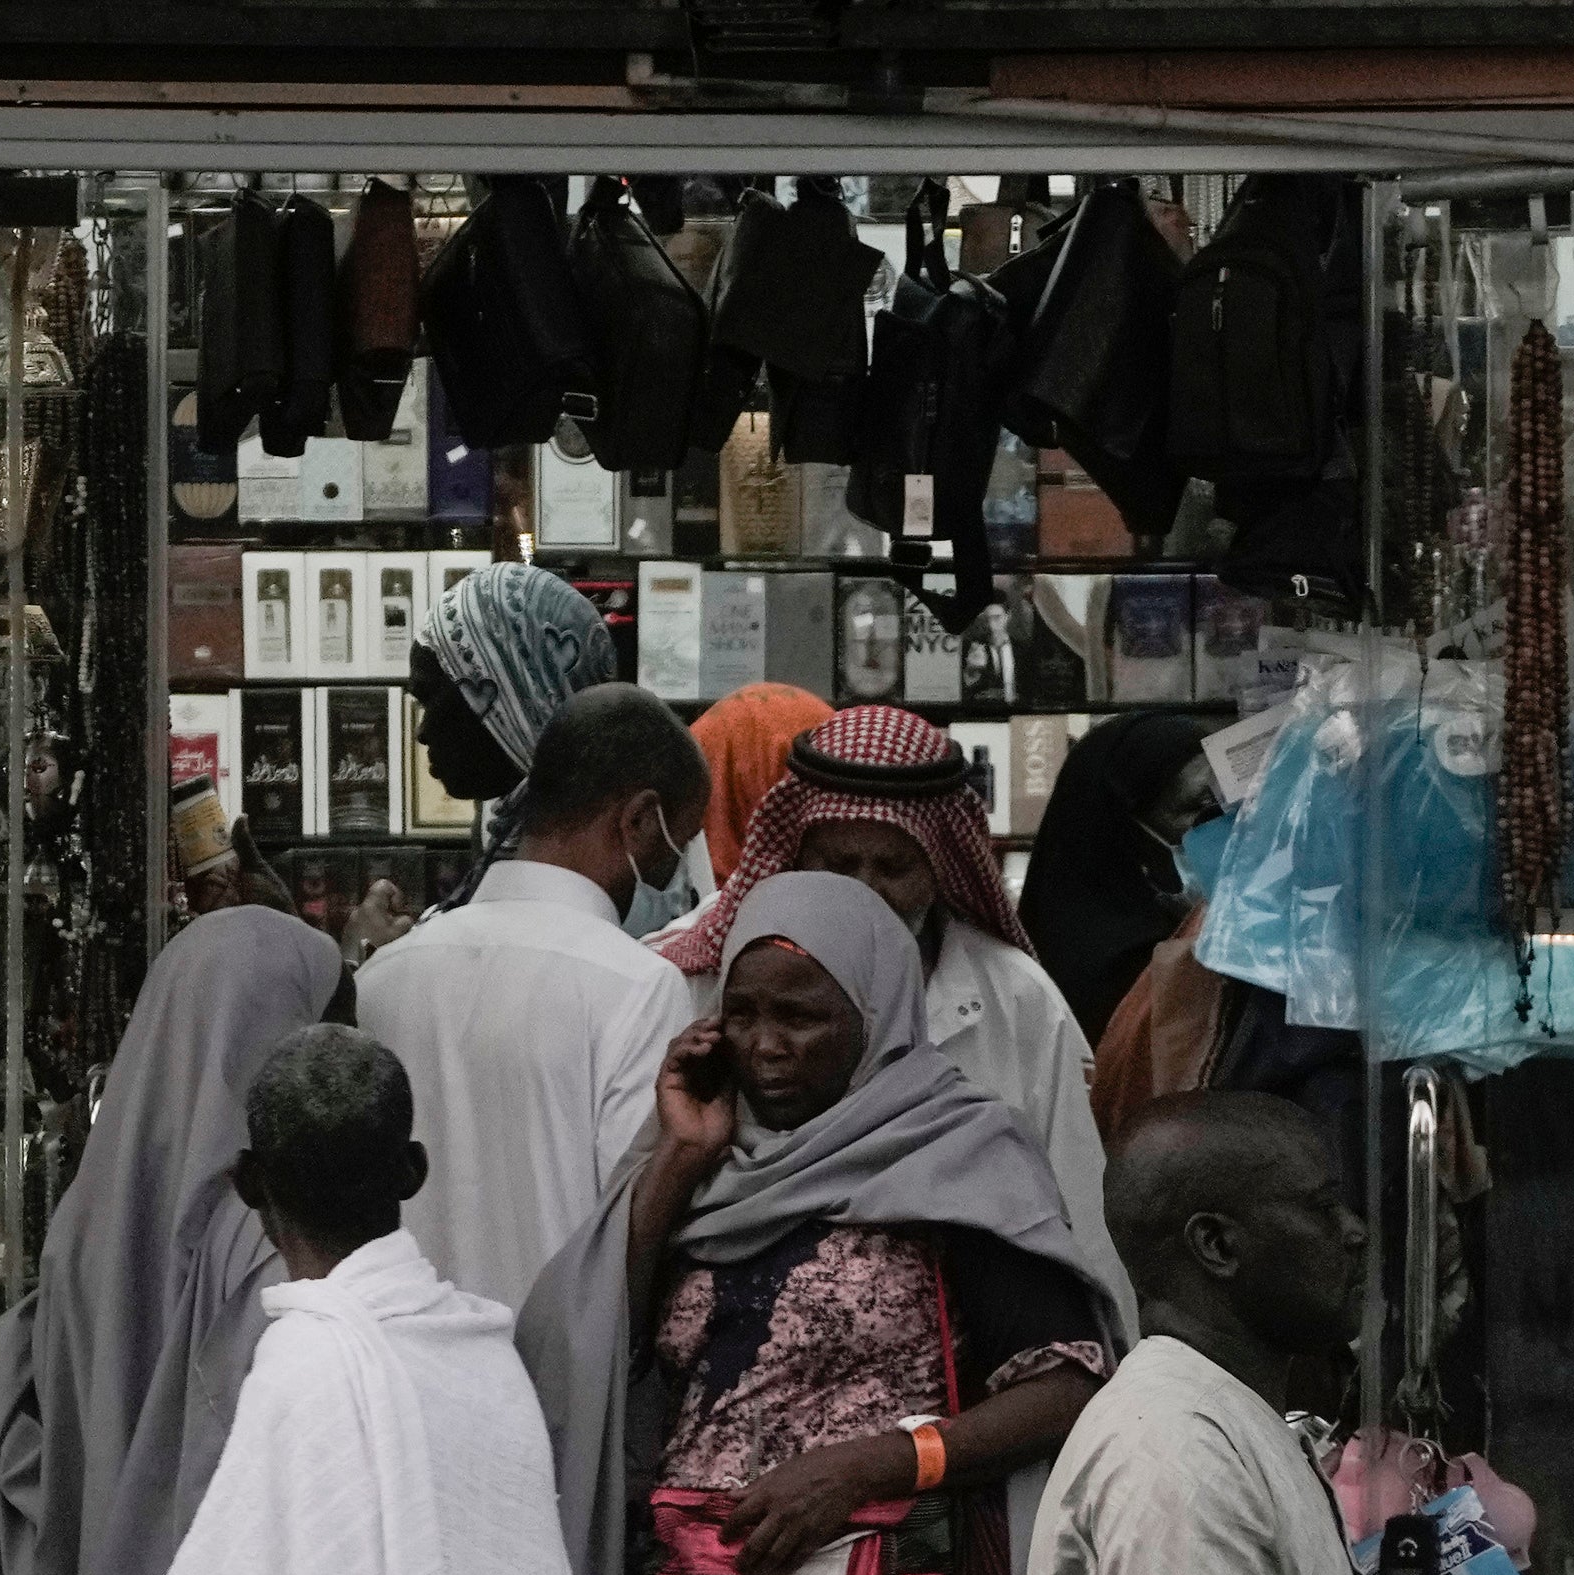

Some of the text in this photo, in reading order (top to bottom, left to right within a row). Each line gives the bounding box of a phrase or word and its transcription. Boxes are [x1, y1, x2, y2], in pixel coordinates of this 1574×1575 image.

[906, 615, 947, 634] ME
[906, 634, 961, 655] NYC
[1025, 719, 1047, 795] BOSS
